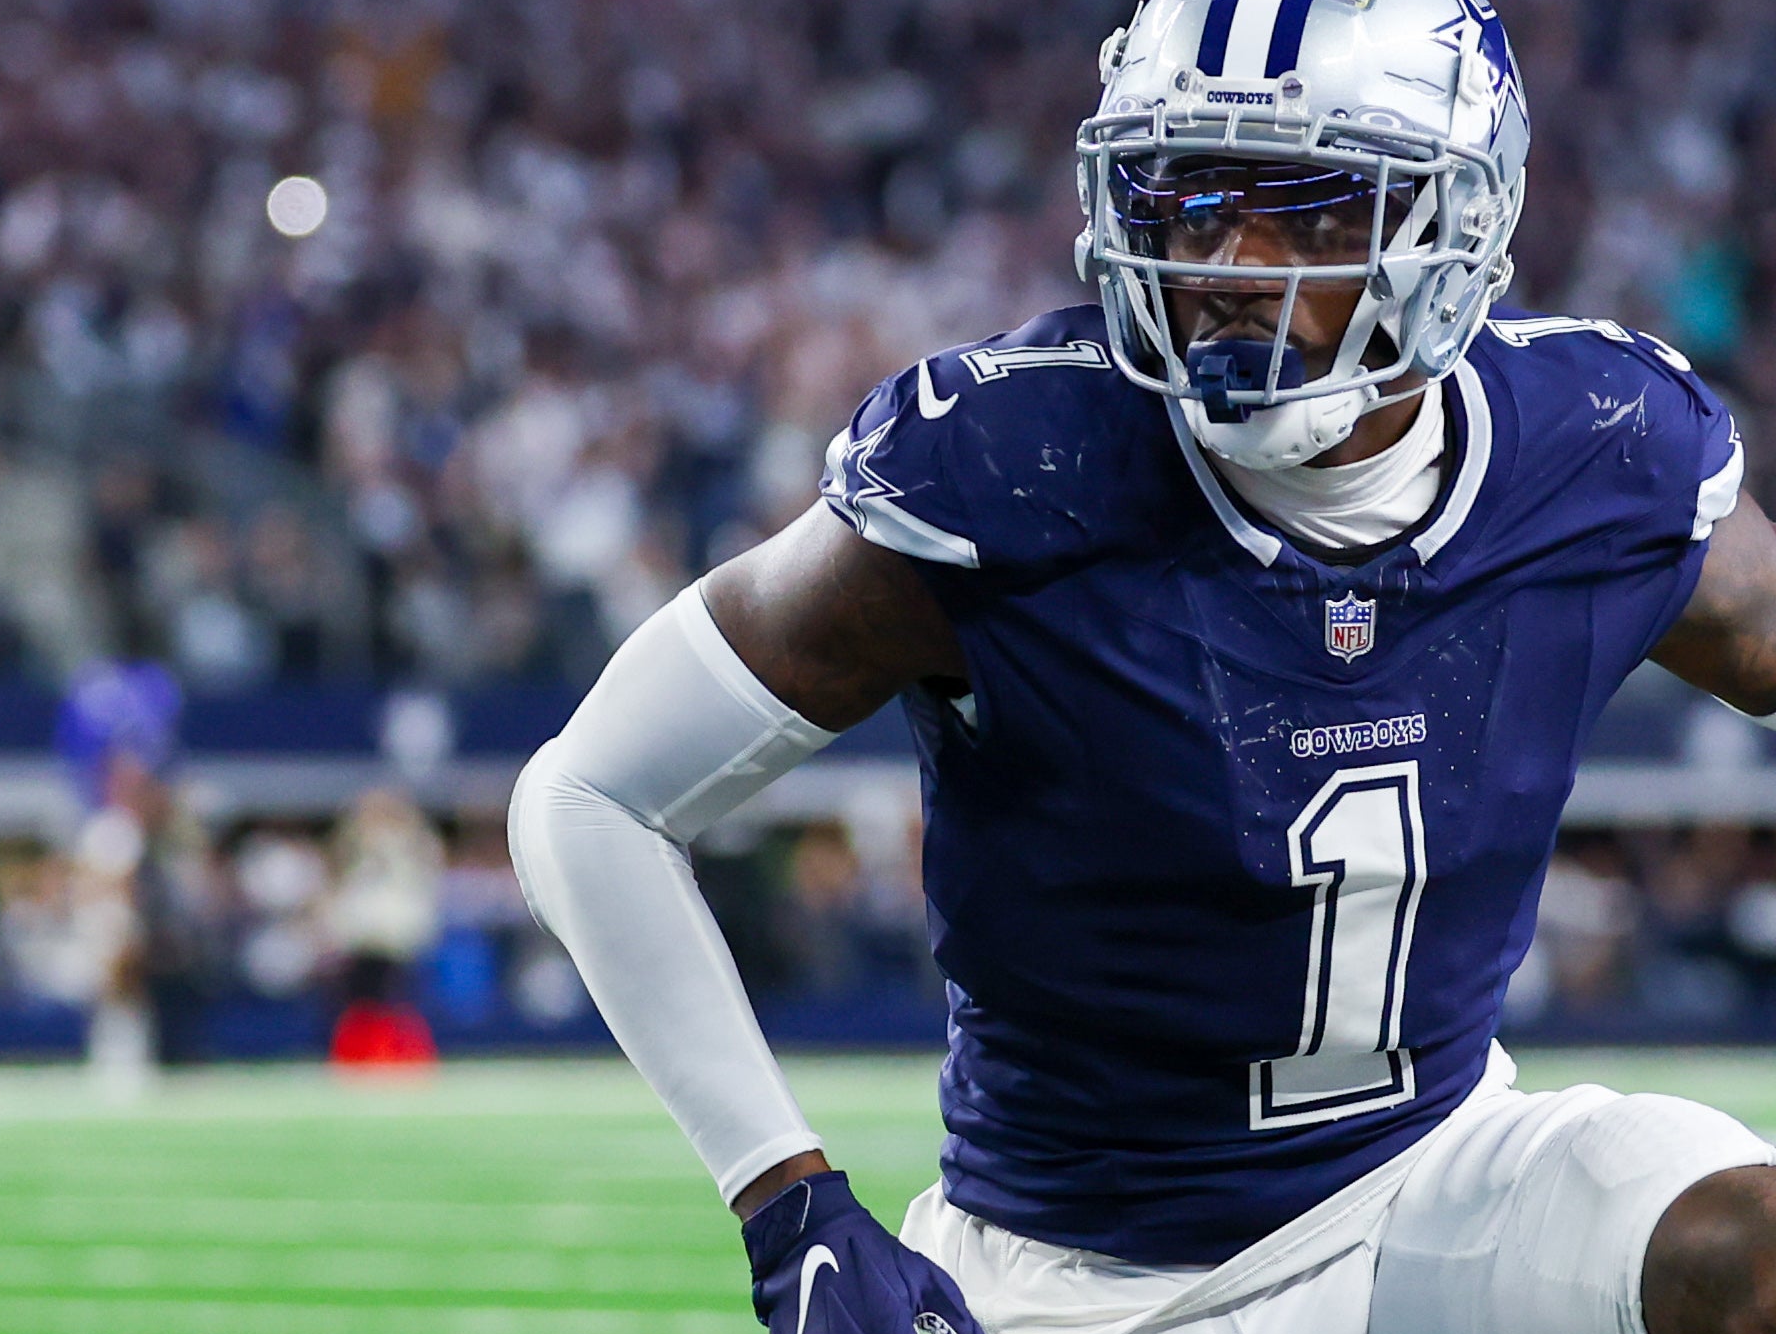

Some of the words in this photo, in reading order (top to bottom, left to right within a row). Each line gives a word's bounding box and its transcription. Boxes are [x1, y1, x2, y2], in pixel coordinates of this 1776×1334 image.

[1206, 89, 1275, 106] COWBOYS
[958, 339, 1113, 385] 1
[1333, 624, 1367, 650] NFL
[1291, 713, 1427, 758] COWBOYS
[1249, 759, 1428, 1131] 1
